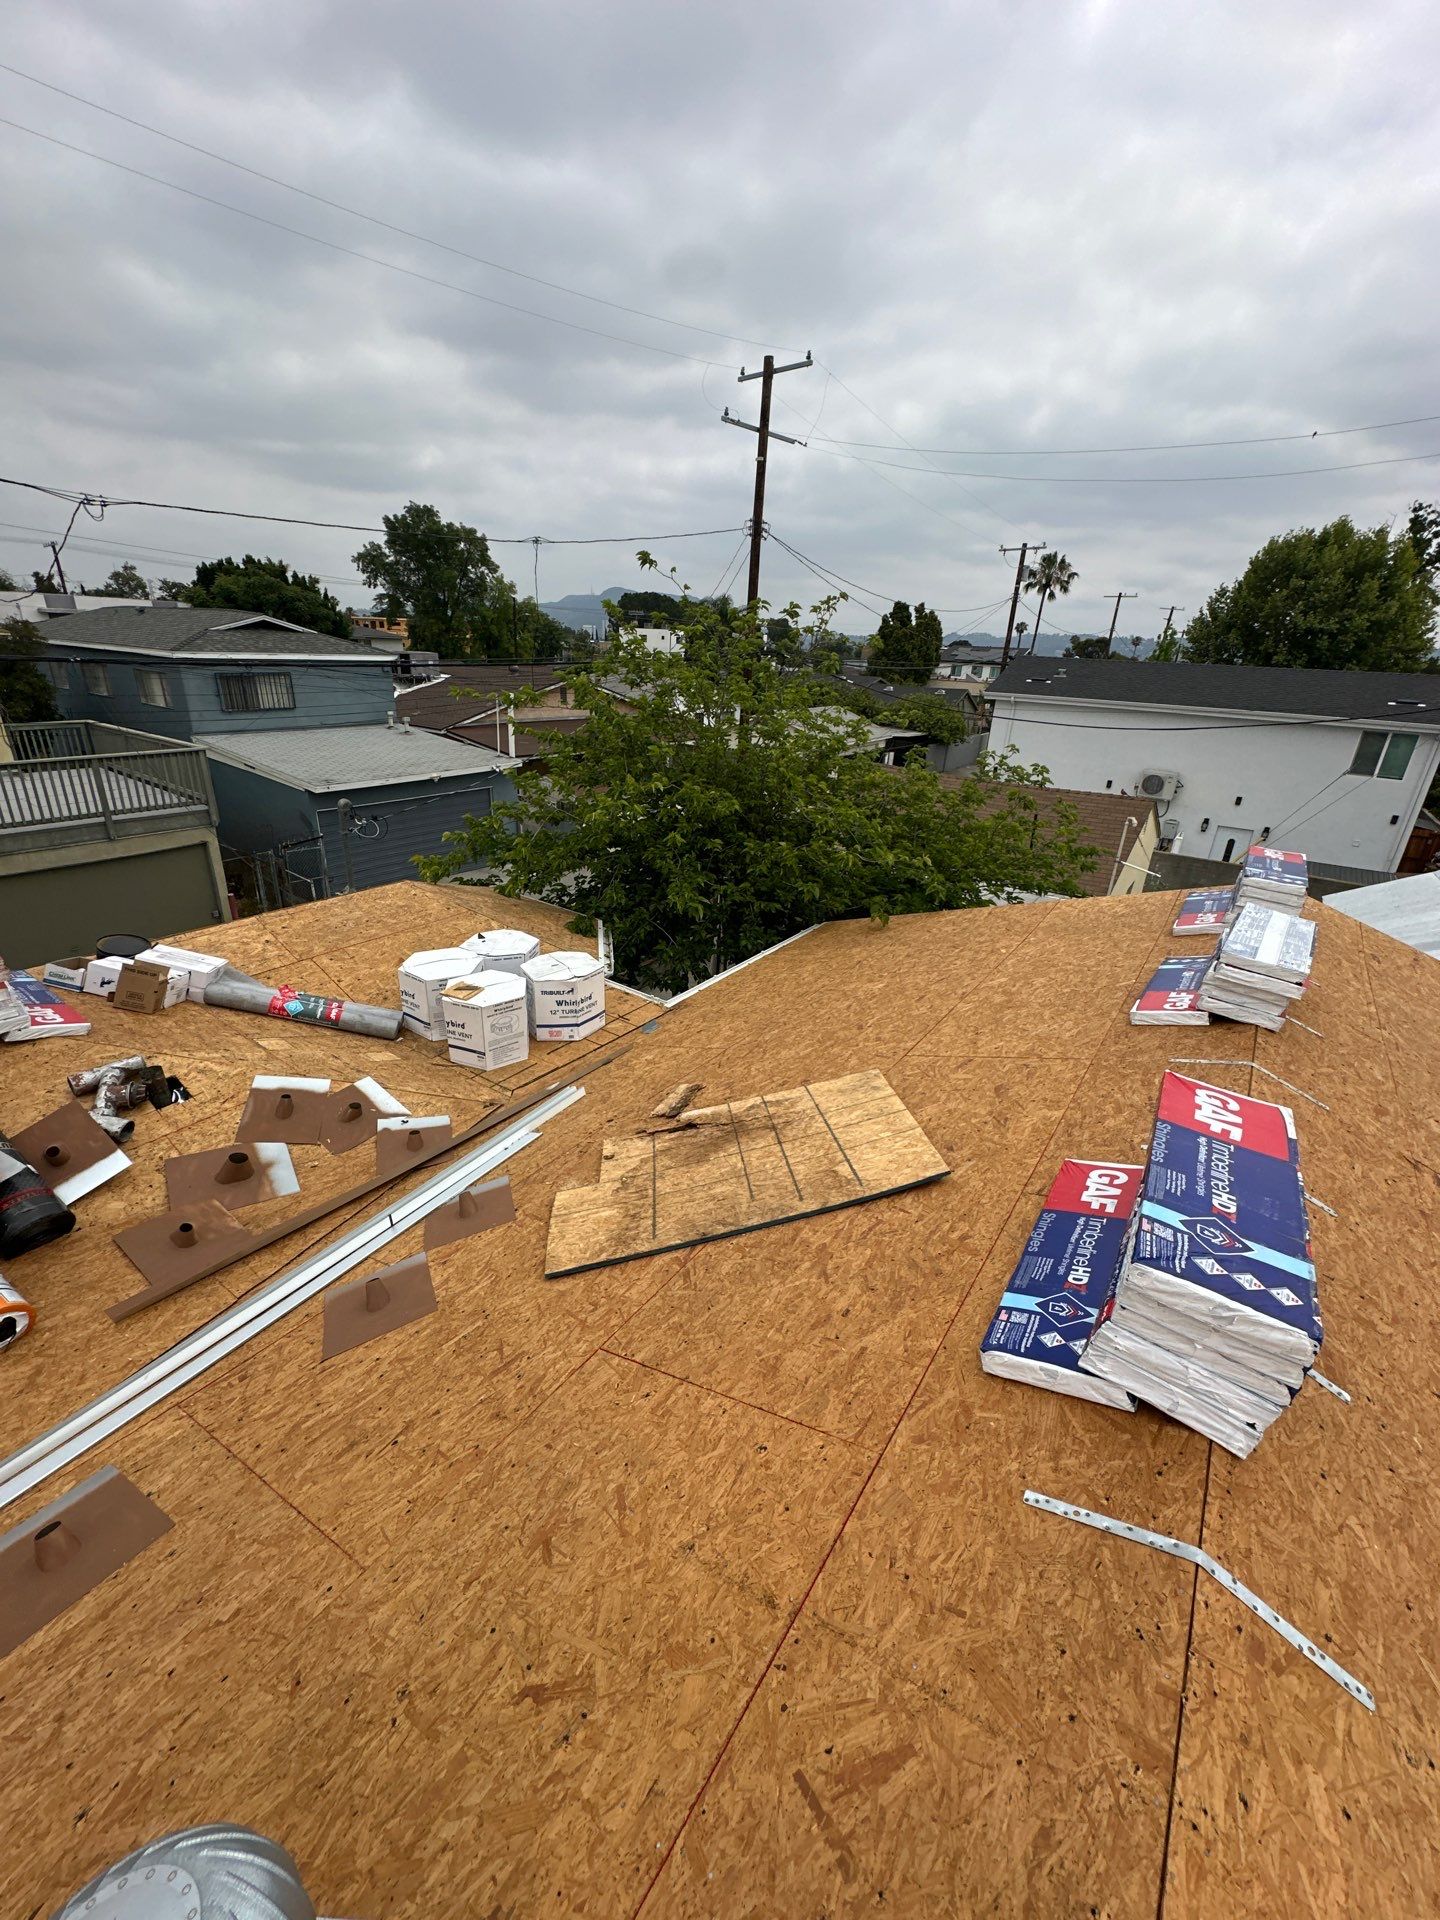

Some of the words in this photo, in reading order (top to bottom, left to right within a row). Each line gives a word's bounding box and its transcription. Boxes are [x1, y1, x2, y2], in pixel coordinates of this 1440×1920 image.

[555, 993, 593, 1007] Whirlybird
[1163, 991, 1194, 1009] GAF
[445, 1020, 465, 1030] ybird
[457, 1032, 473, 1040] VENT
[1194, 1088, 1243, 1142] GAF
[1080, 1169, 1129, 1213] GAF
[1028, 1212, 1057, 1252] Shingles
